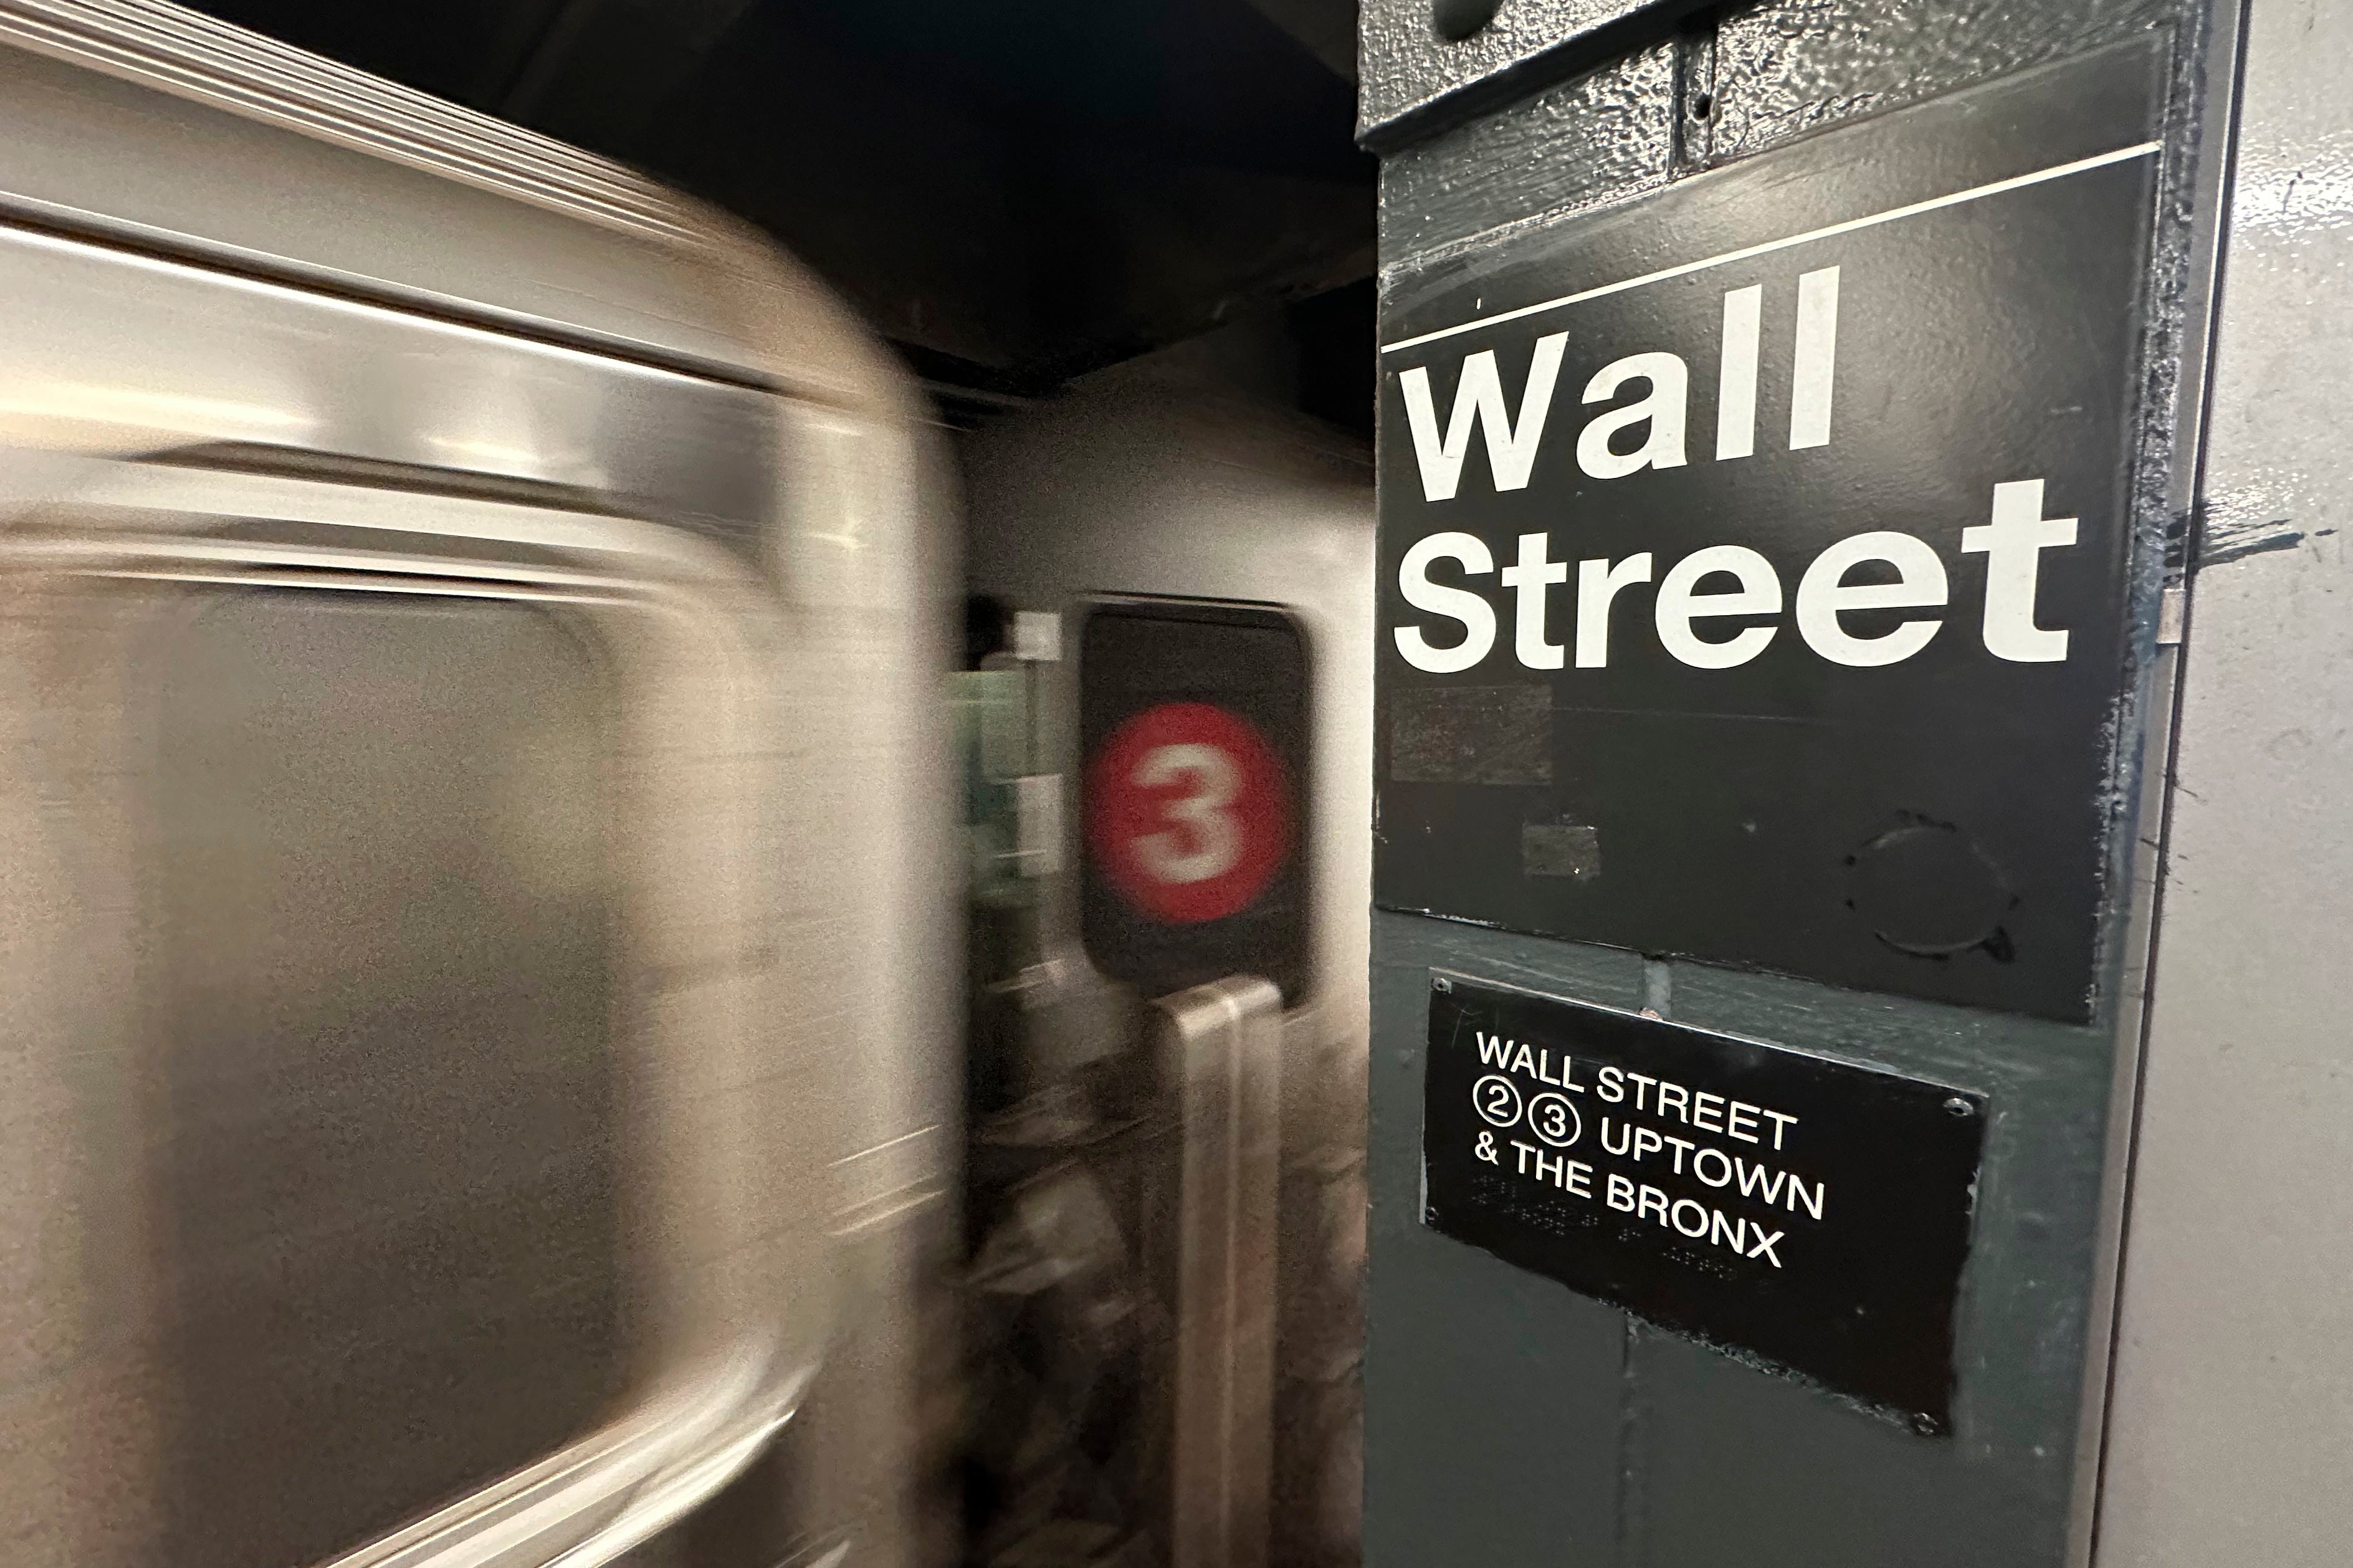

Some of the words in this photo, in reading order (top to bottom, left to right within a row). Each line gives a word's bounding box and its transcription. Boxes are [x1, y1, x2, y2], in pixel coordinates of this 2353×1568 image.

[1398, 265, 1840, 502] Wall
[1393, 478, 2079, 674] Street
[1130, 743, 1244, 884] 3
[1475, 1031, 1585, 1094] WALL
[1596, 1066, 1799, 1150] STREET
[1474, 1131, 1499, 1166] &
[1510, 1139, 1593, 1199] THE
[1606, 1173, 1785, 1269] BRONX
[1601, 1117, 1825, 1220] UPTOWN
